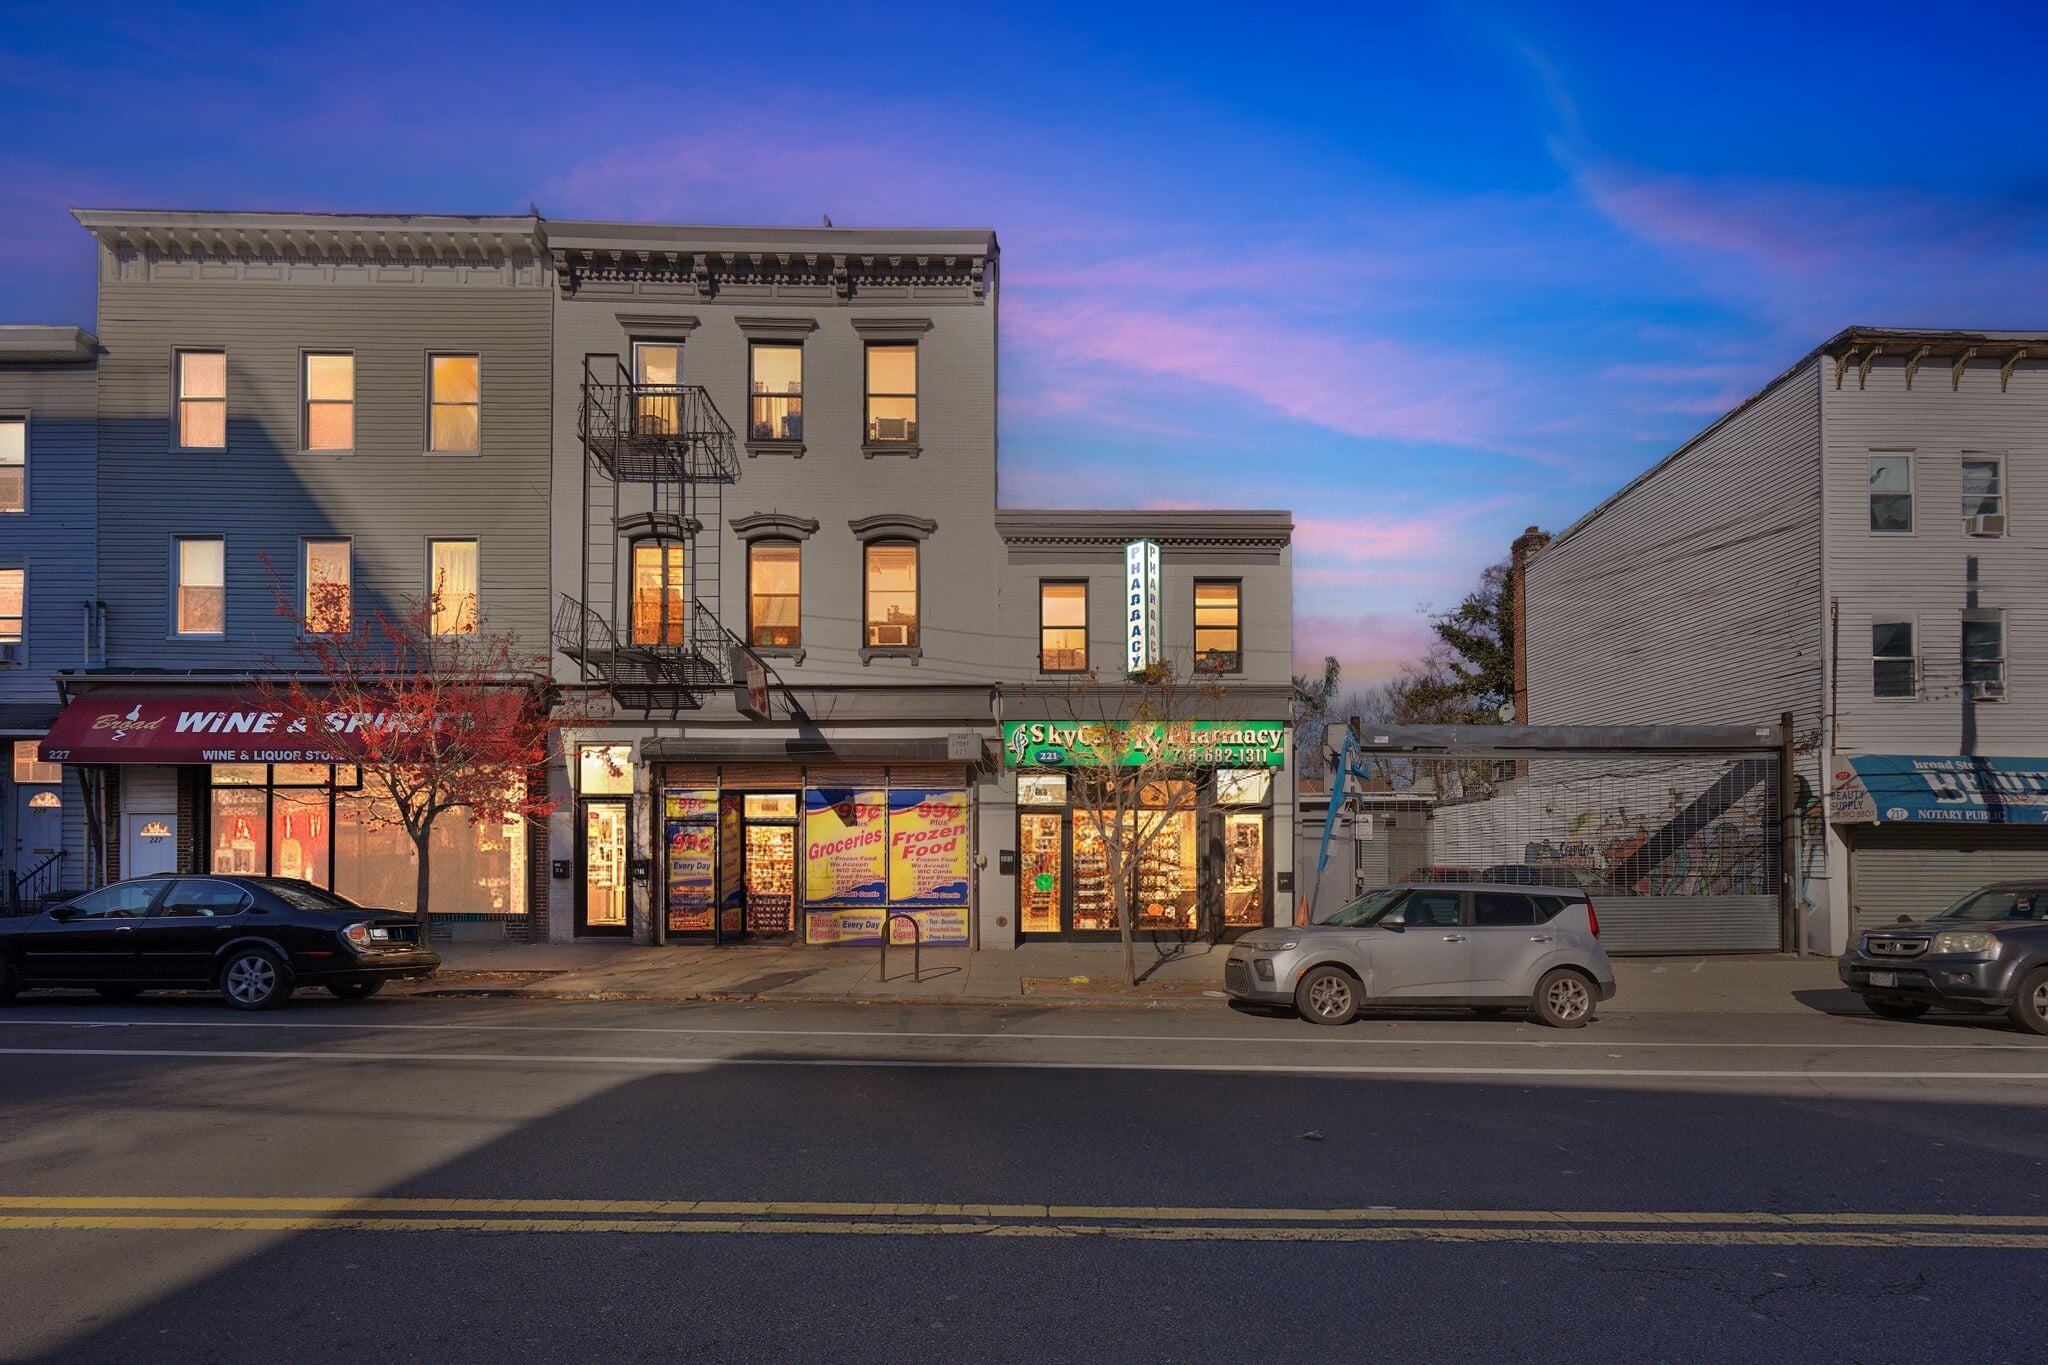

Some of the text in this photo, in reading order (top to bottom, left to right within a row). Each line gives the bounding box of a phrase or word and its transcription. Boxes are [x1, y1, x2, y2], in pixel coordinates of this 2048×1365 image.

[92, 714, 166, 730] Broad
[175, 712, 283, 733] WINE
[286, 717, 307, 734] &
[48, 750, 71, 760] 227
[202, 750, 236, 761] WINE
[240, 750, 250, 761] &
[254, 750, 301, 761] LIQUOR
[1040, 752, 1058, 760] 221
[1832, 790, 1865, 800] BEAUTY
[1831, 800, 1864, 811] SUPPLY
[839, 802, 881, 822] 99¢
[918, 802, 960, 821] 99¢
[1891, 810, 1904, 819] 217
[1918, 810, 2006, 820] NOTARY PUBLIC
[892, 824, 966, 846] Frozen
[808, 829, 882, 861] Groceries
[902, 838, 957, 860] Food
[674, 862, 710, 871] Every Day
[842, 921, 880, 929] Every Day
